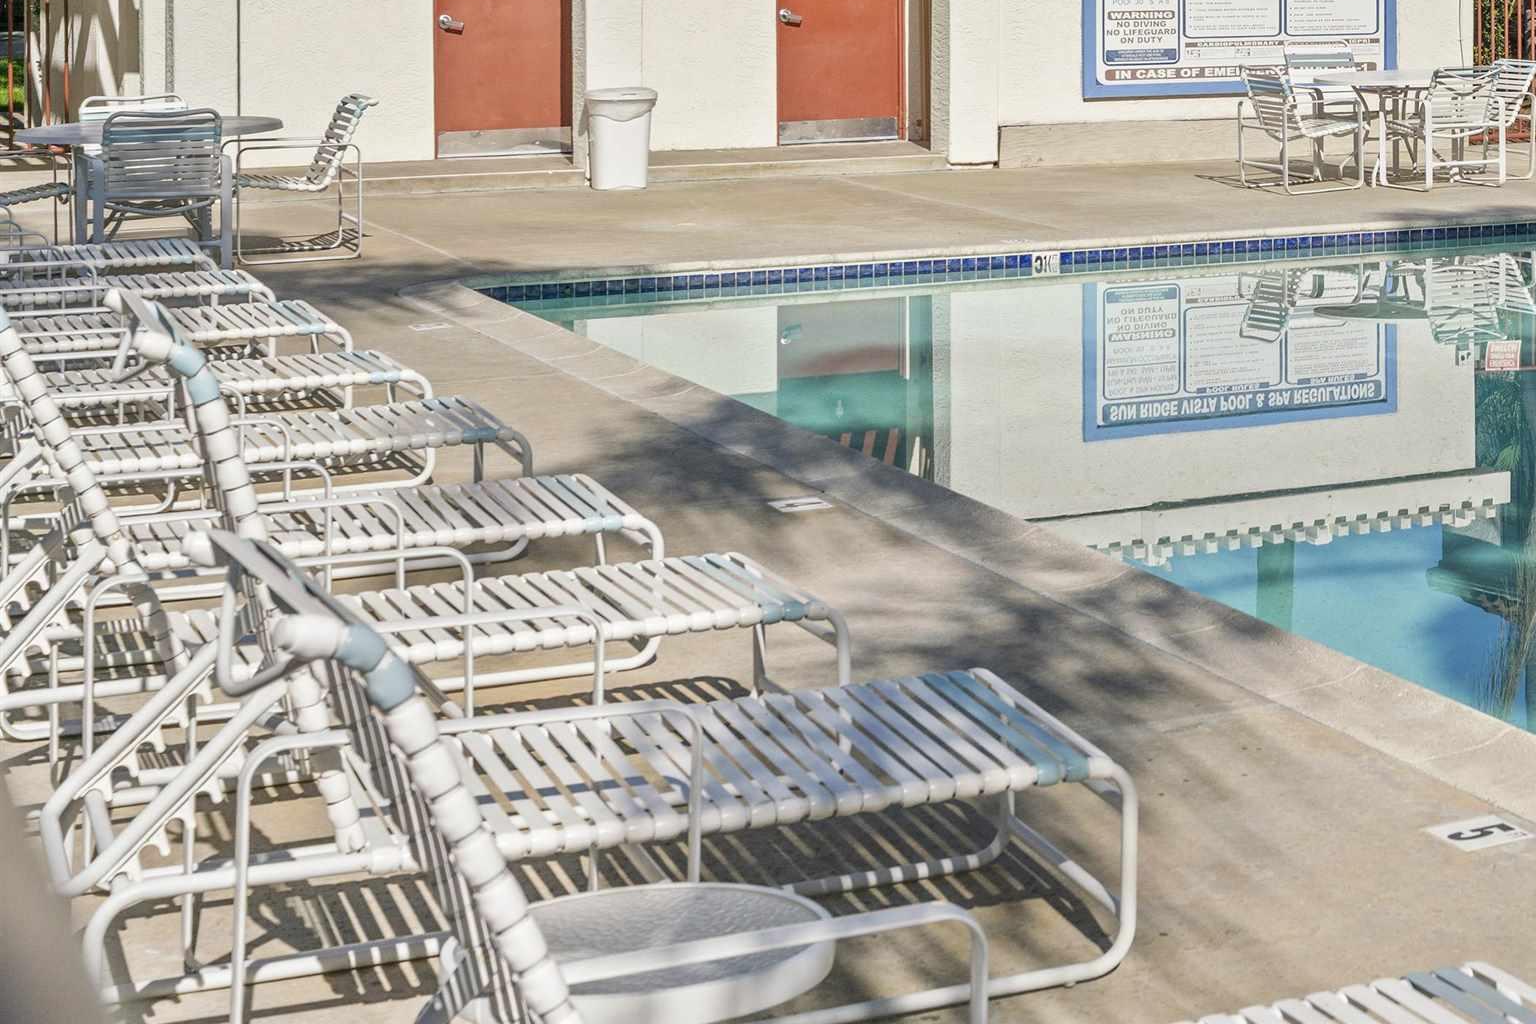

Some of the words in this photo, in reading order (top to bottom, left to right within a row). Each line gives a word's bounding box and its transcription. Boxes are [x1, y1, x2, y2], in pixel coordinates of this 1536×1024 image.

[1109, 11, 1174, 20] WARNING
[1133, 20, 1167, 28] DIVING
[1123, 28, 1177, 36] LIFEGUARD
[1114, 70, 1132, 80] IN
[1135, 69, 1177, 80] CASE
[1179, 68, 1201, 78] OF
[1447, 823, 1516, 841] 5
